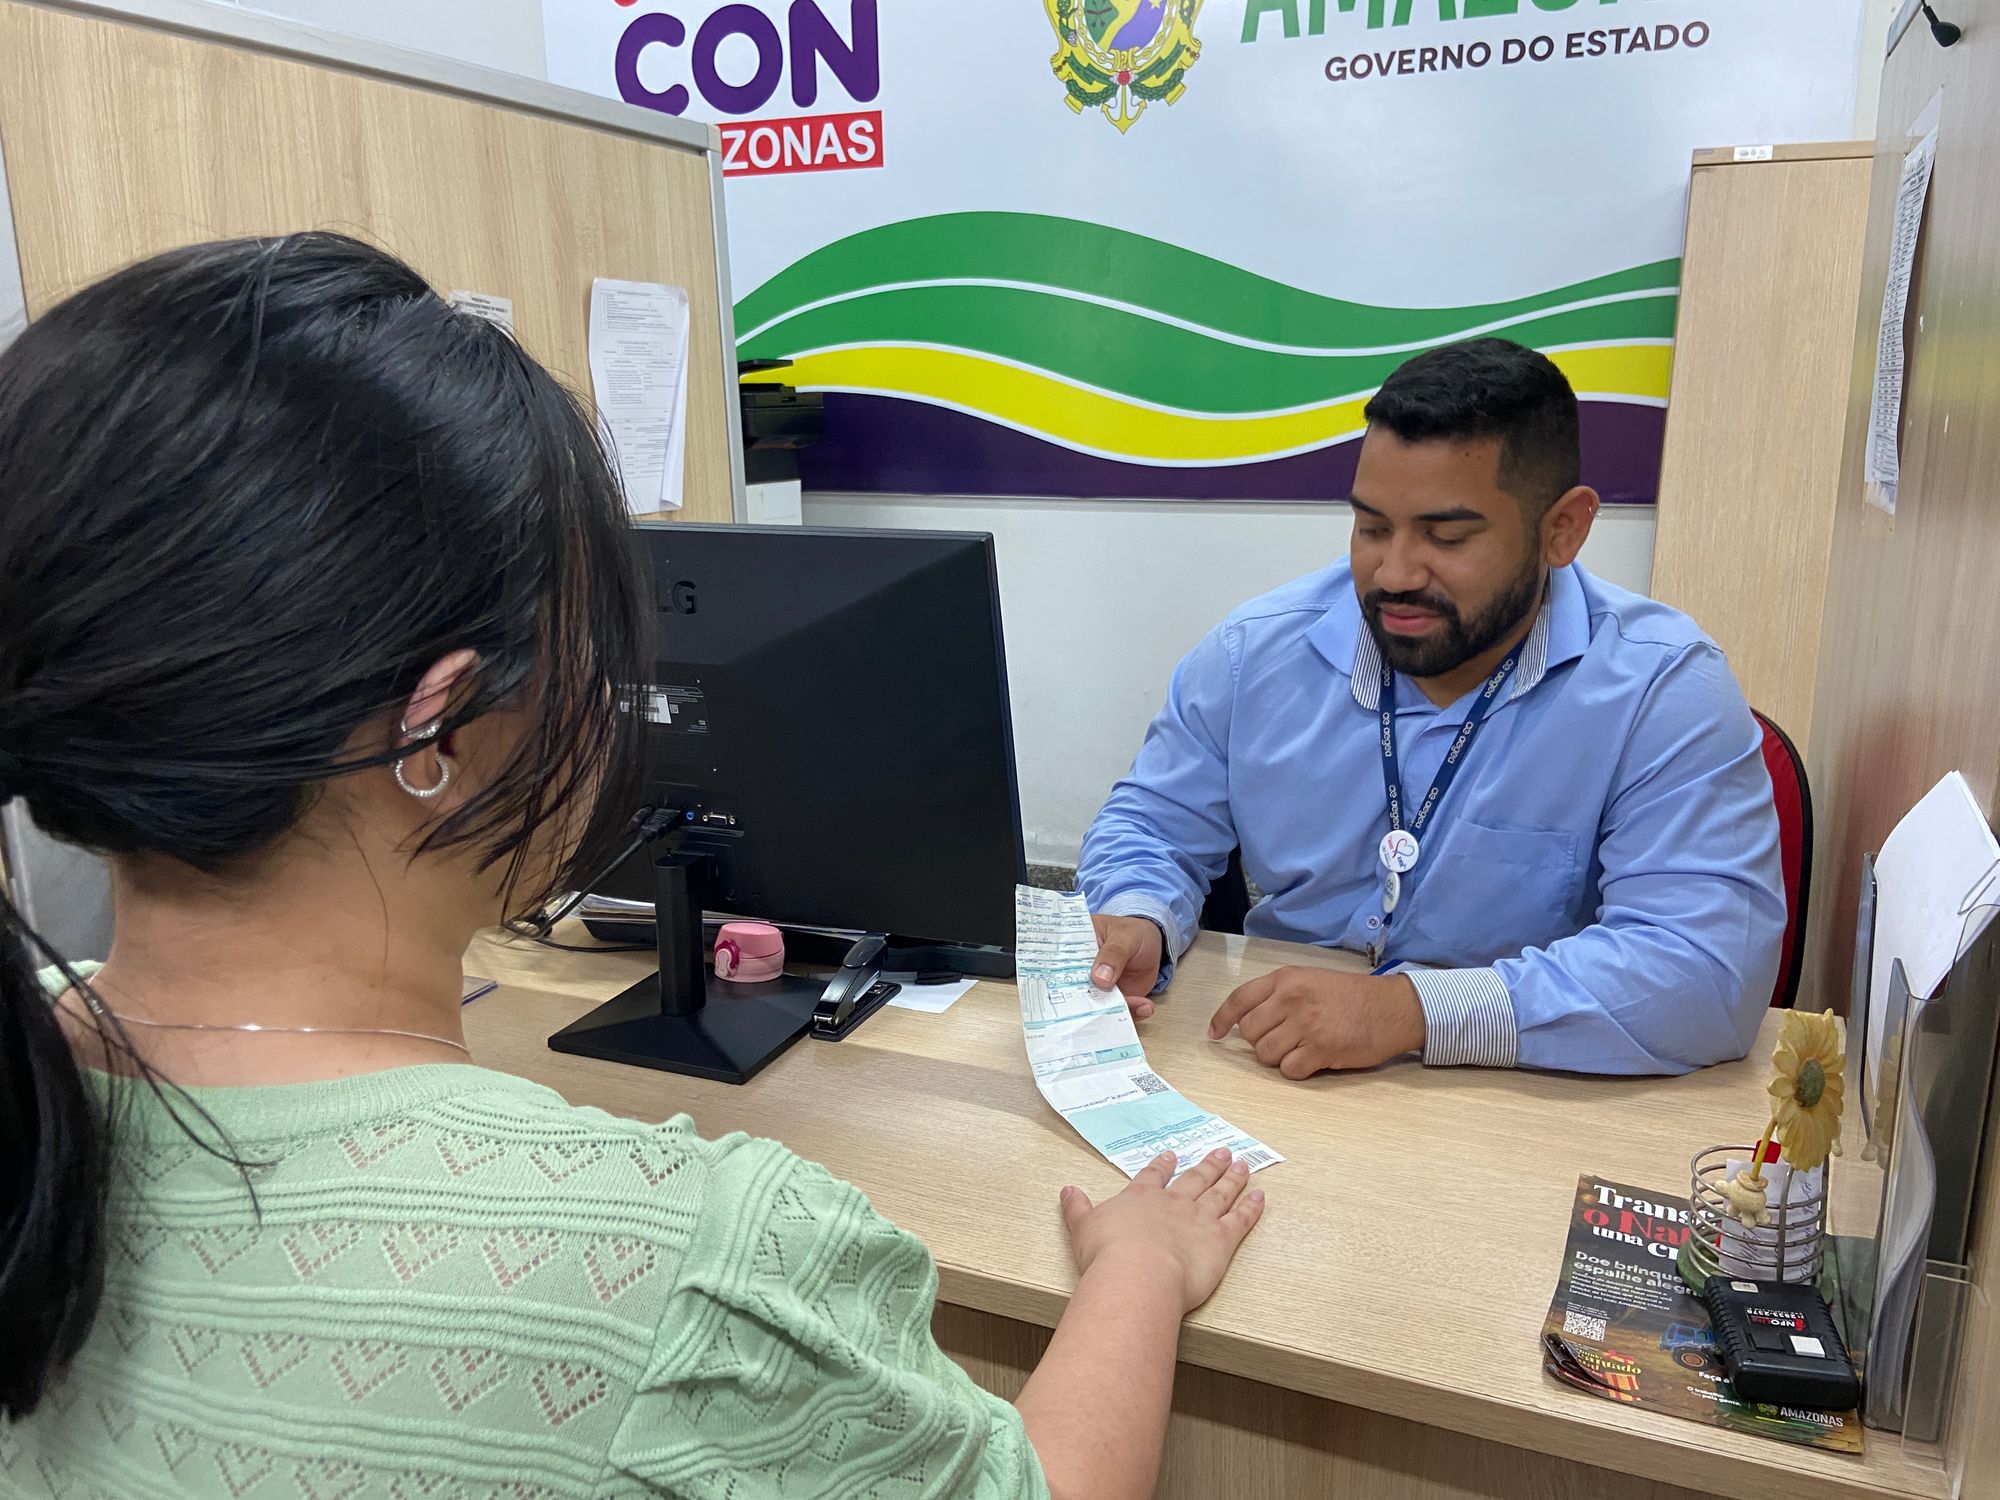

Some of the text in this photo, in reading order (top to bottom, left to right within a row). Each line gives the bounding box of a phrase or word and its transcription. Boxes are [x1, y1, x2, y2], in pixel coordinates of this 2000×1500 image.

[615, 0, 880, 116] CON
[1325, 20, 1710, 82] GOVERNO DO ESTADO
[722, 120, 876, 170] ZONAS
[1484, 671, 1505, 698] aegea
[1382, 727, 1392, 757] aegea
[1447, 735, 1466, 764] aegea
[1390, 800, 1400, 829] aegea
[1415, 801, 1432, 828] aegea
[1583, 1209, 1609, 1226] o
[1592, 1225, 1644, 1247] uma
[1575, 1250, 1611, 1267] Doe
[1573, 1262, 1642, 1284] espalhe
[1780, 1406, 1844, 1428] AMAZONAS
